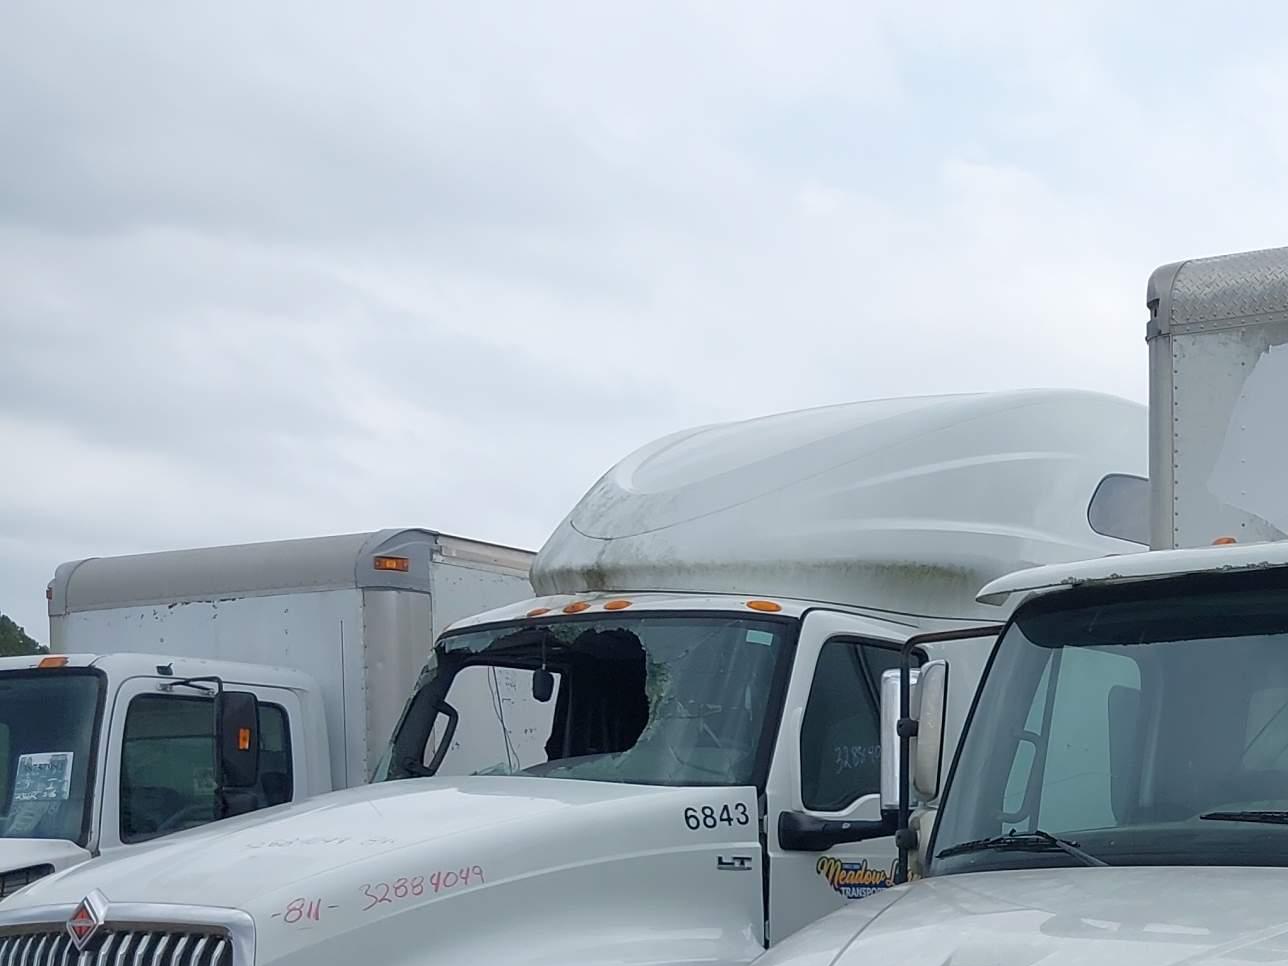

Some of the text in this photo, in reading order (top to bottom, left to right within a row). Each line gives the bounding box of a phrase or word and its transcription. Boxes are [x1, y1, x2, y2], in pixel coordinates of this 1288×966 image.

[684, 802, 749, 830] 6843
[717, 855, 753, 868] LT
[816, 856, 887, 889] Meadow
